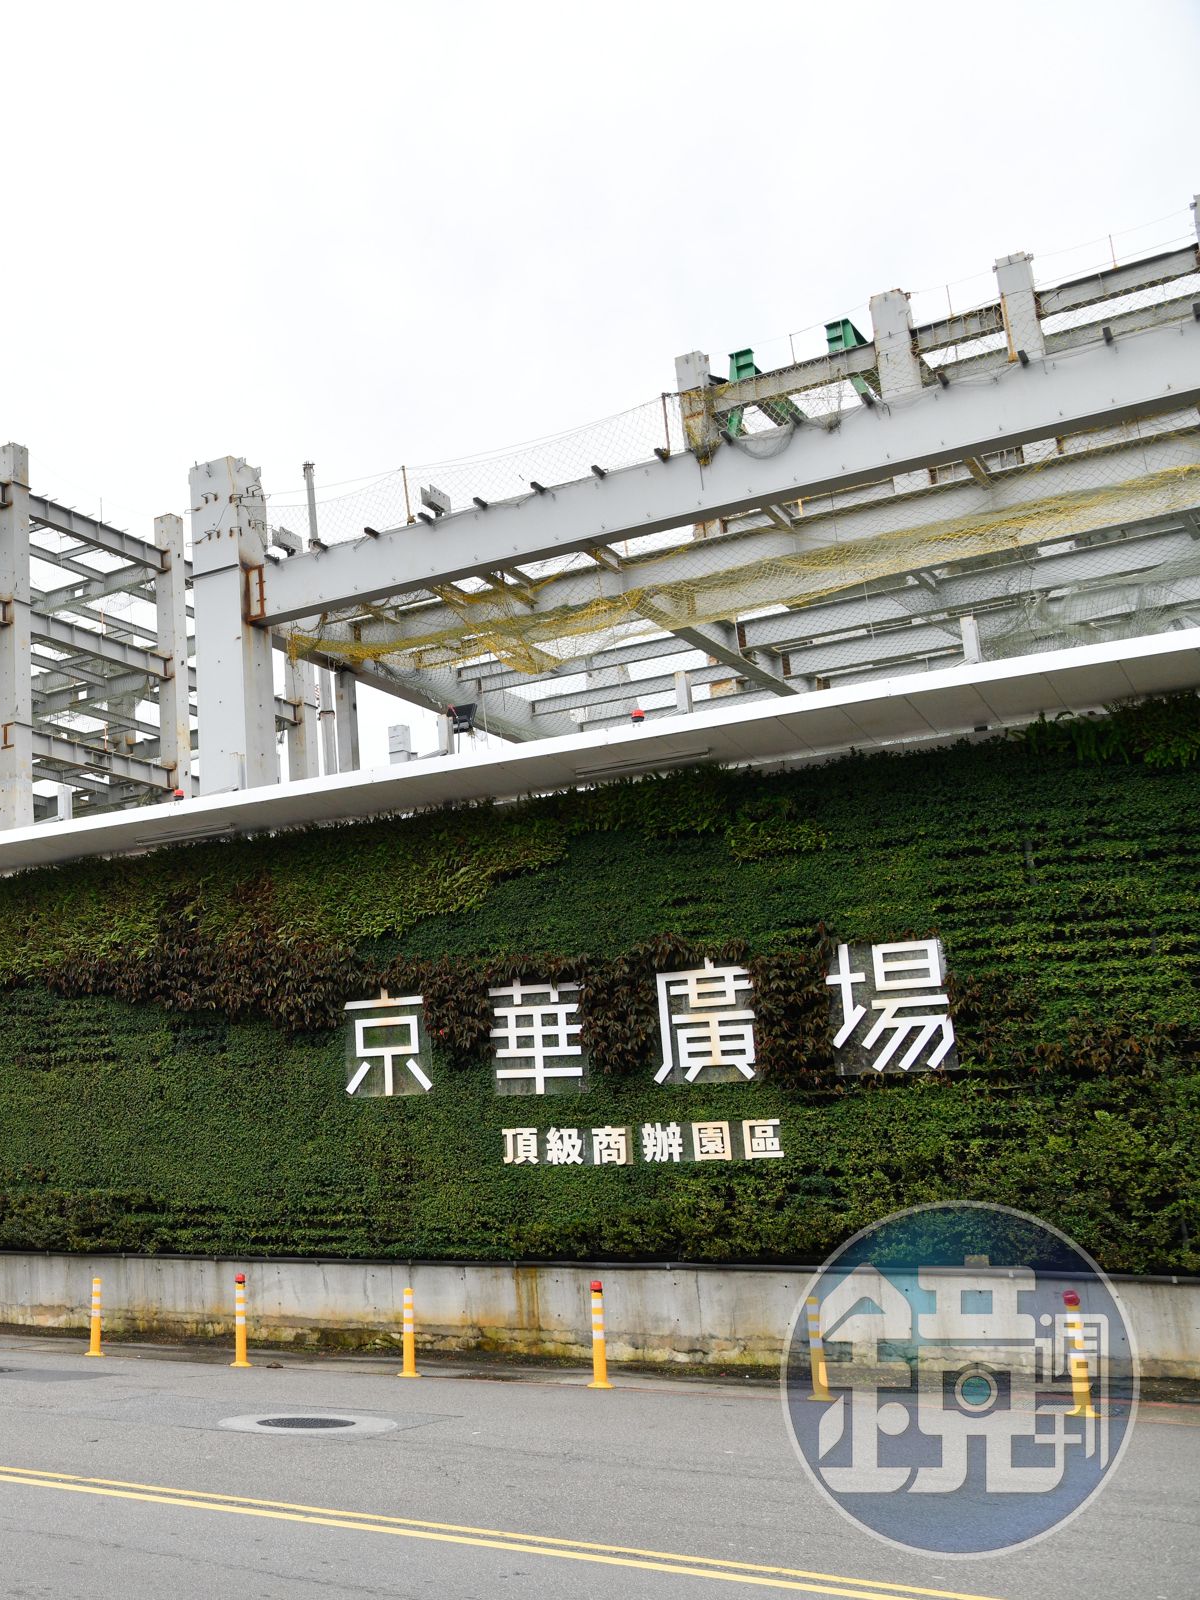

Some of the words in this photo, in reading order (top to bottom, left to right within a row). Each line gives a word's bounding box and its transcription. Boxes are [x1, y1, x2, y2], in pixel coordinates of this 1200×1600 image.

[344, 938, 955, 1096] 京華廣場
[502, 1119, 785, 1165] 頂級商辦園區
